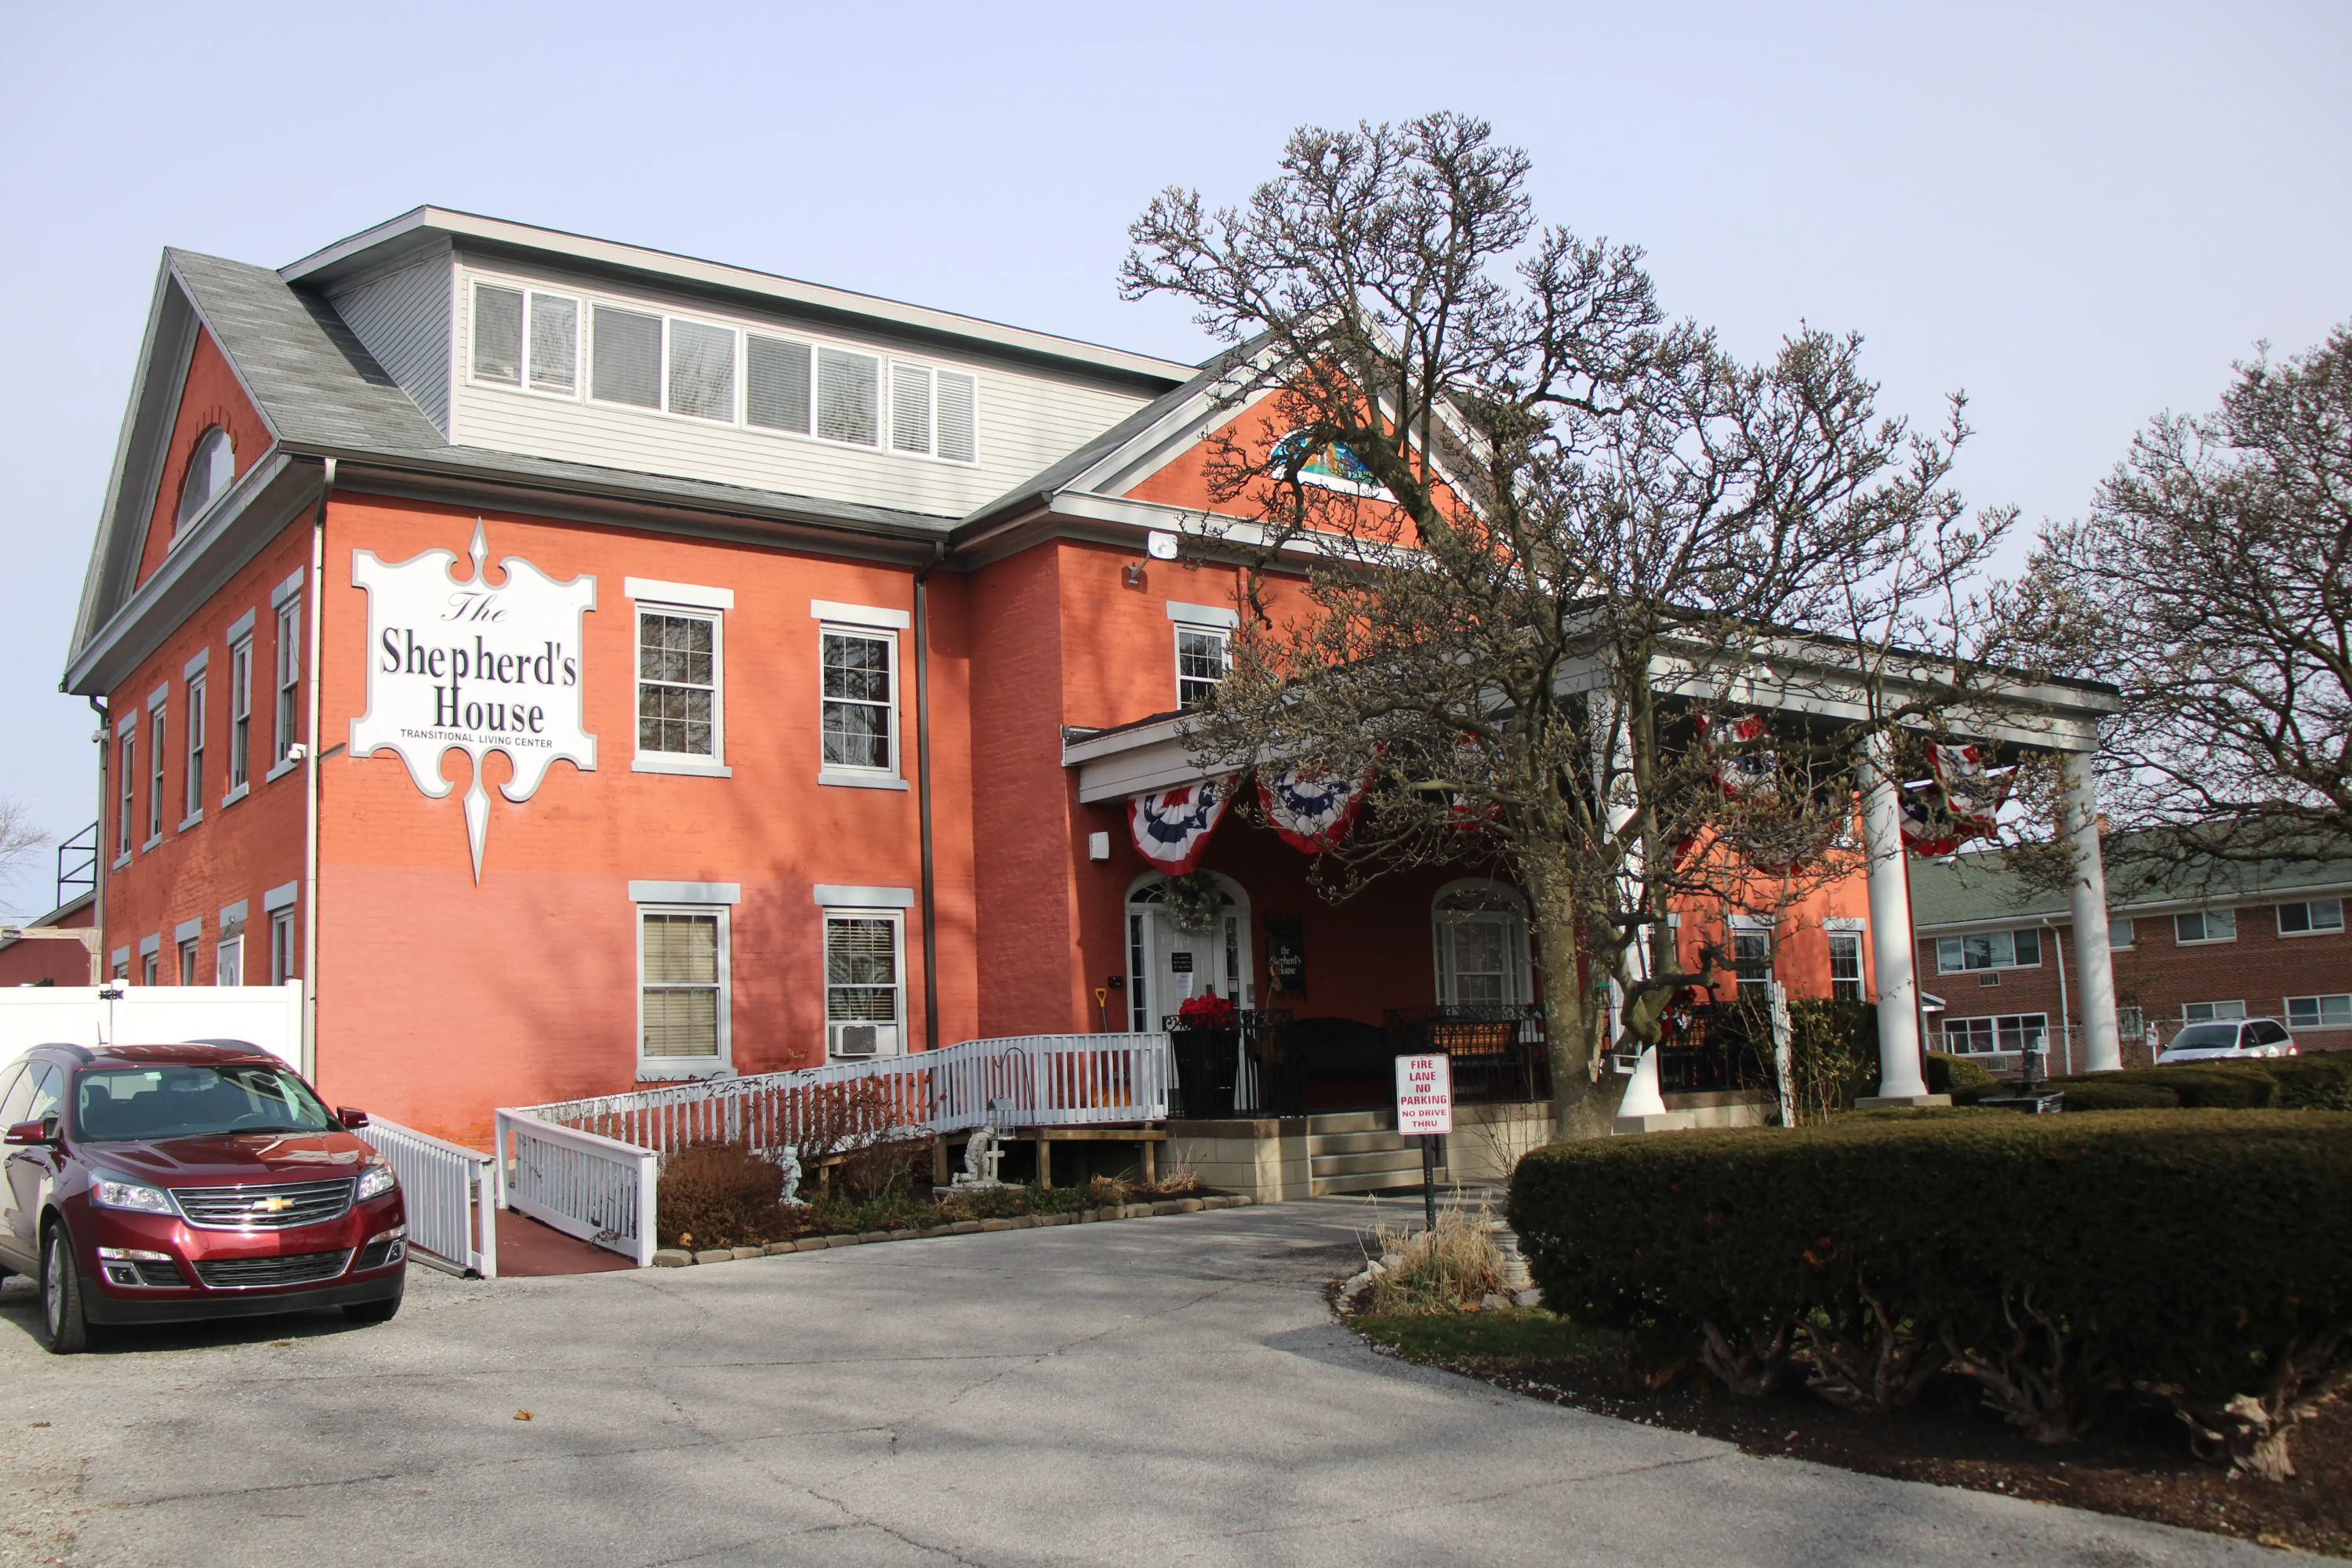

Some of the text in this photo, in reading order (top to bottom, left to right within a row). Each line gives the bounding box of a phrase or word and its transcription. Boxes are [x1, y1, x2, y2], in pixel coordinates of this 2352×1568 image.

[440, 591, 509, 622] The
[381, 626, 578, 688] Shepherd's
[432, 684, 545, 734] House
[400, 728, 553, 748] TRANSITIONAL LIVING CENTER
[1410, 1060, 1433, 1069] FIRE
[1409, 1072, 1436, 1081] LANE
[1415, 1083, 1431, 1093] NO
[1400, 1095, 1447, 1105] PARKING
